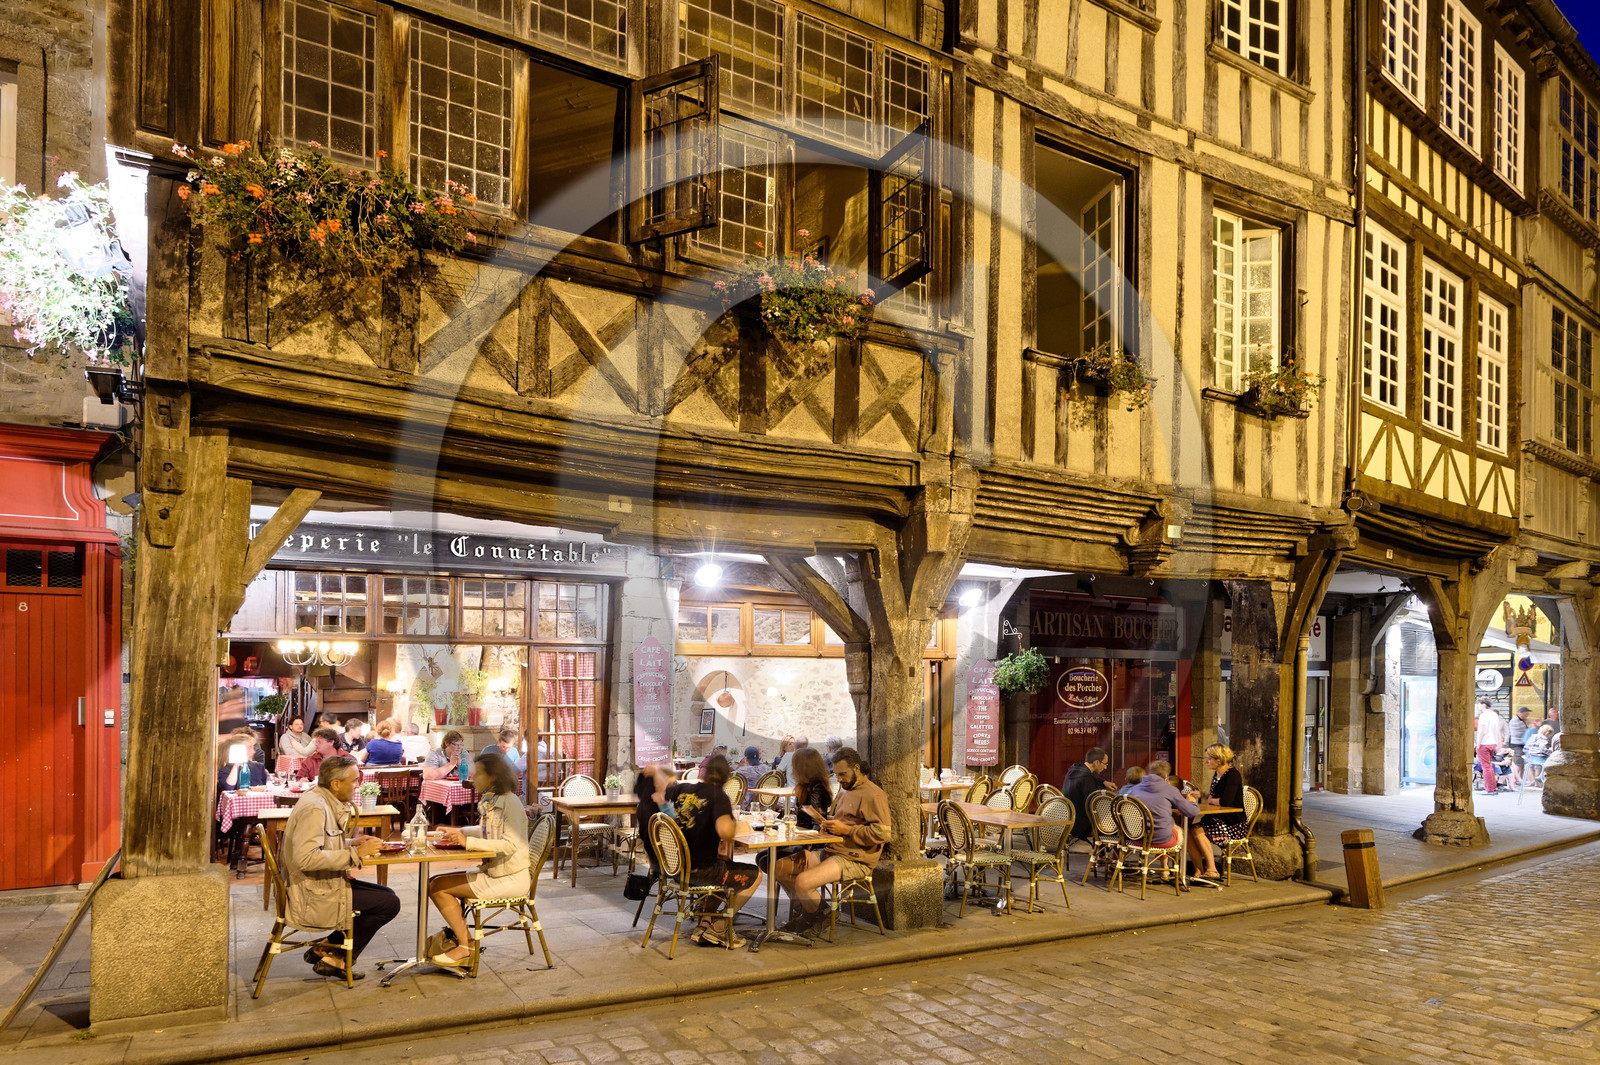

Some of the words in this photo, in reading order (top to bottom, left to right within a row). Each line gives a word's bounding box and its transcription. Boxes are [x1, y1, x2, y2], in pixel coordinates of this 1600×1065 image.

[18, 601, 28, 612] 8
[1031, 611, 1105, 638] ARTISAN
[640, 658, 663, 667] LAIT
[1069, 673, 1098, 682] Boucherie
[1064, 683, 1076, 692] des
[1077, 683, 1102, 692] Porches
